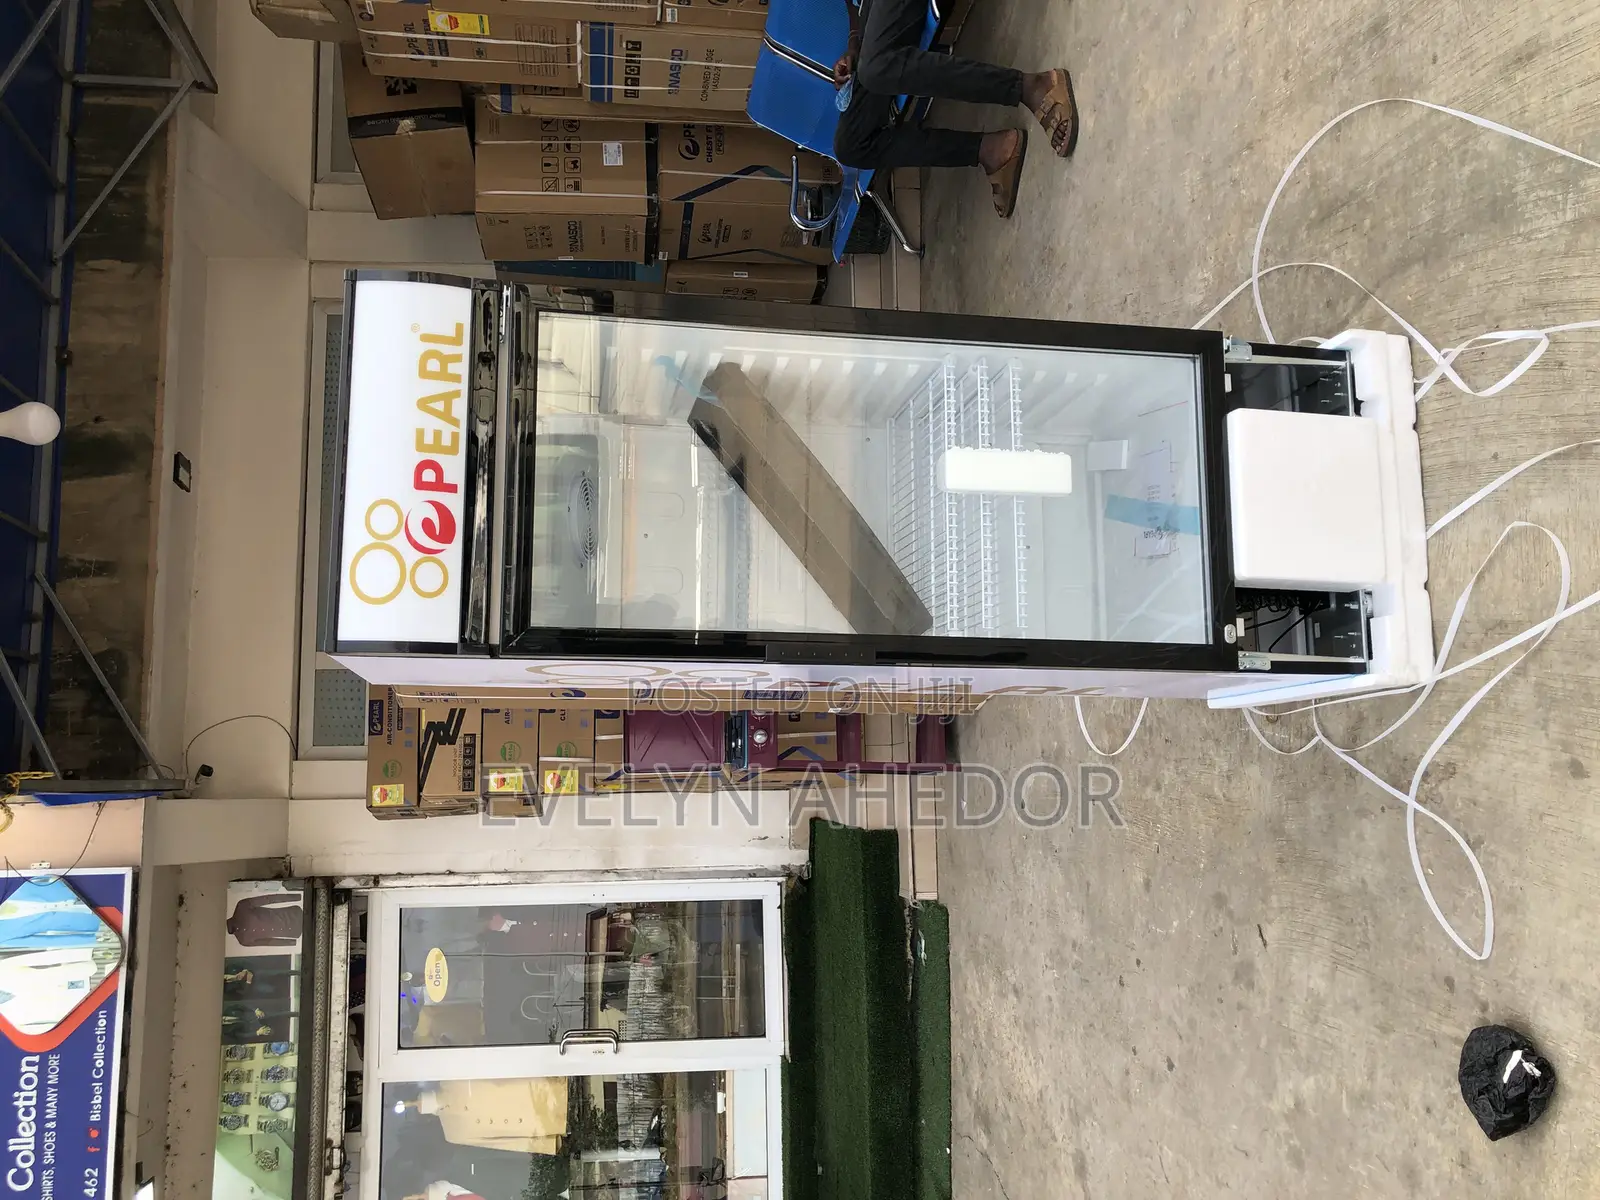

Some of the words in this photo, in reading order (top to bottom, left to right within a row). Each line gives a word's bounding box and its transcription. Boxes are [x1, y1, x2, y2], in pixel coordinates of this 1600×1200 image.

[700, 70, 711, 102] COMBINED
[434, 962, 442, 986] Open
[91, 1010, 108, 1078] Collection
[47, 1053, 60, 1084] MORE
[45, 1087, 58, 1118] MANY
[88, 1082, 104, 1122] Bisbel
[6, 1055, 40, 1192] Collection
[44, 1120, 56, 1128] &
[43, 1131, 56, 1164] SHOES
[83, 1168, 99, 1198] 462
